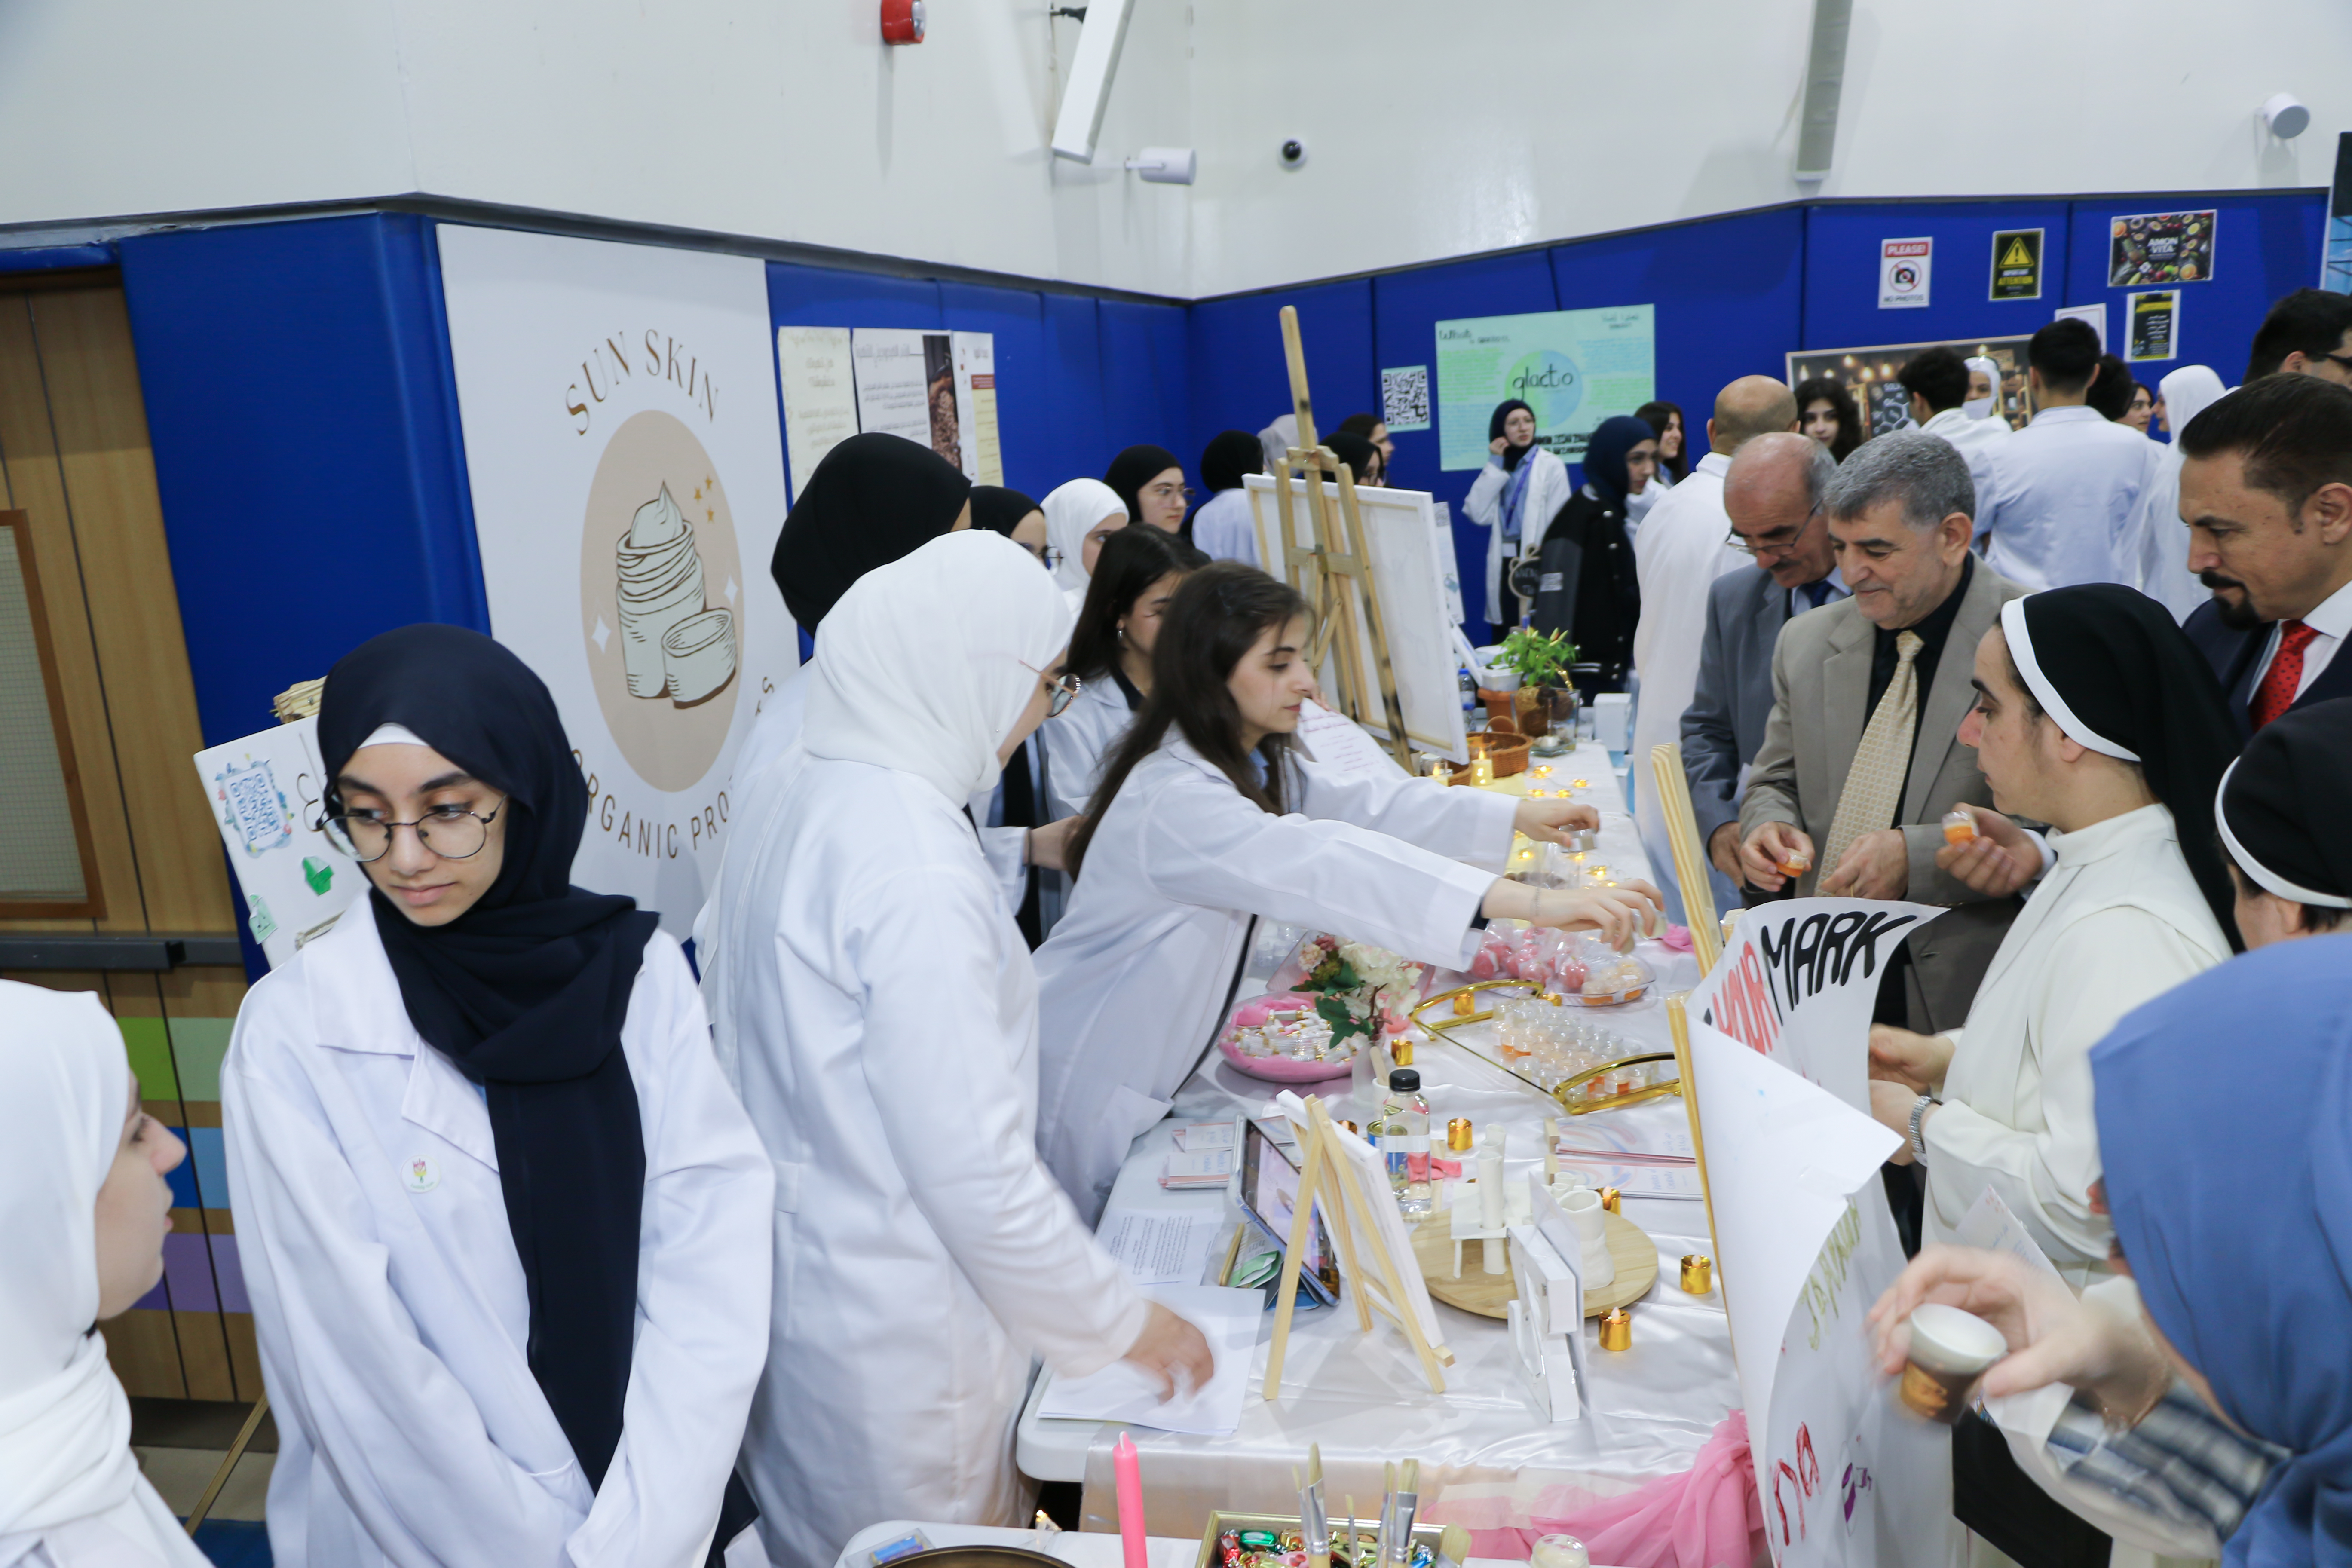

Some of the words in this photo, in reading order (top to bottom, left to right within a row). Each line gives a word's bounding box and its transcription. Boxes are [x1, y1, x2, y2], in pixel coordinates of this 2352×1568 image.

[1887, 243, 1926, 255] PLEASE!
[1895, 294, 1924, 302] PHOTOS
[565, 330, 631, 436] SUN
[645, 329, 719, 423] SKIN
[1512, 364, 1574, 401] glacto
[1761, 911, 1917, 1027] MARK
